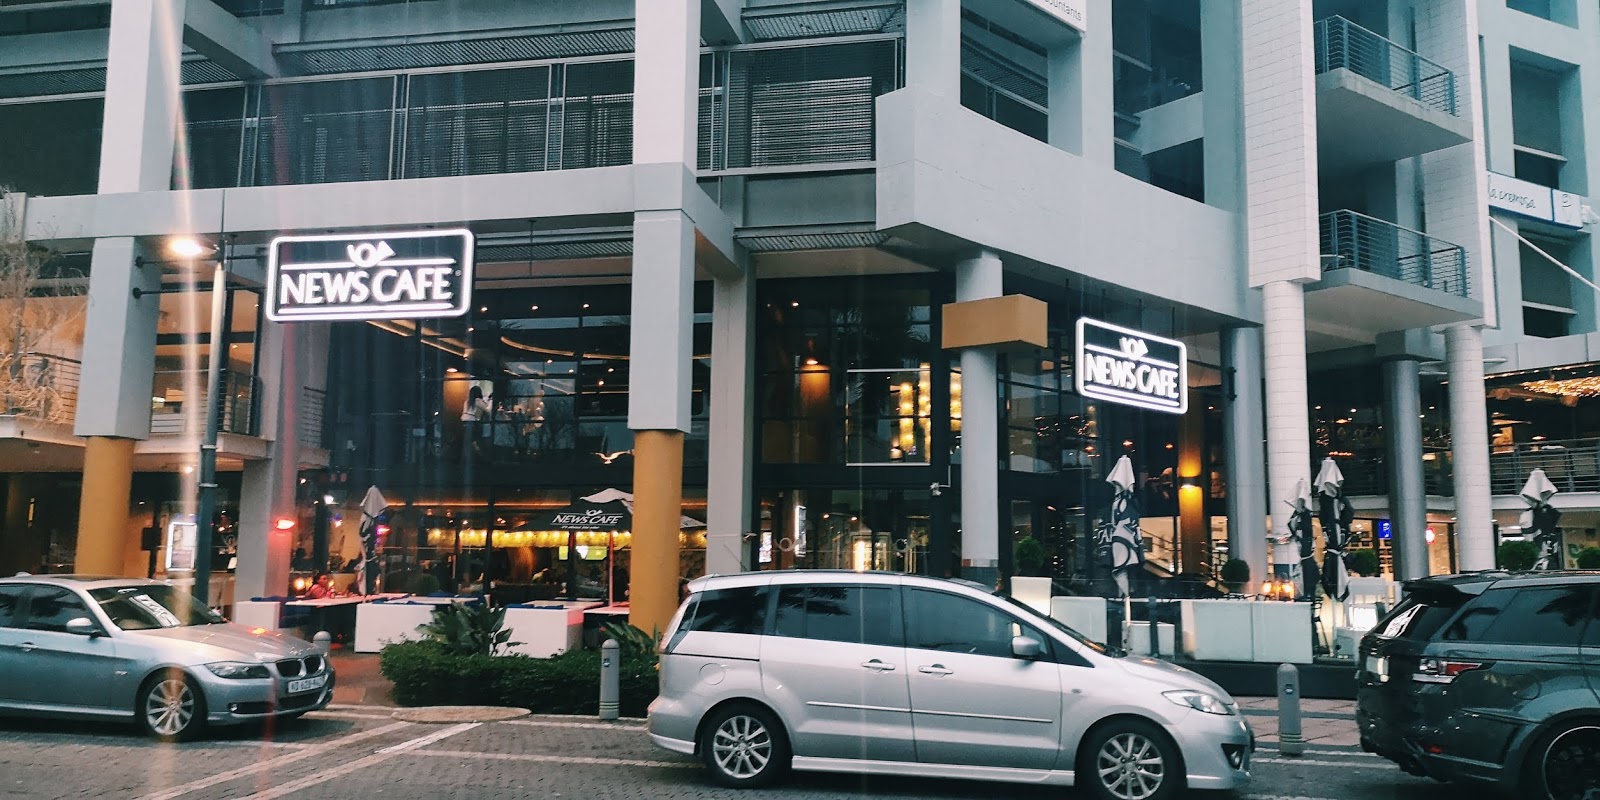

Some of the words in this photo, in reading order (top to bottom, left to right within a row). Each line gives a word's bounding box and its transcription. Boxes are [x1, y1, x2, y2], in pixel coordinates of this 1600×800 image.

[280, 270, 370, 305] NEWS
[372, 267, 454, 303] CAFE
[1084, 352, 1137, 390] NEWS
[1135, 364, 1179, 399] CAFE
[552, 514, 590, 524] NEWS
[589, 515, 624, 524] CAFE
